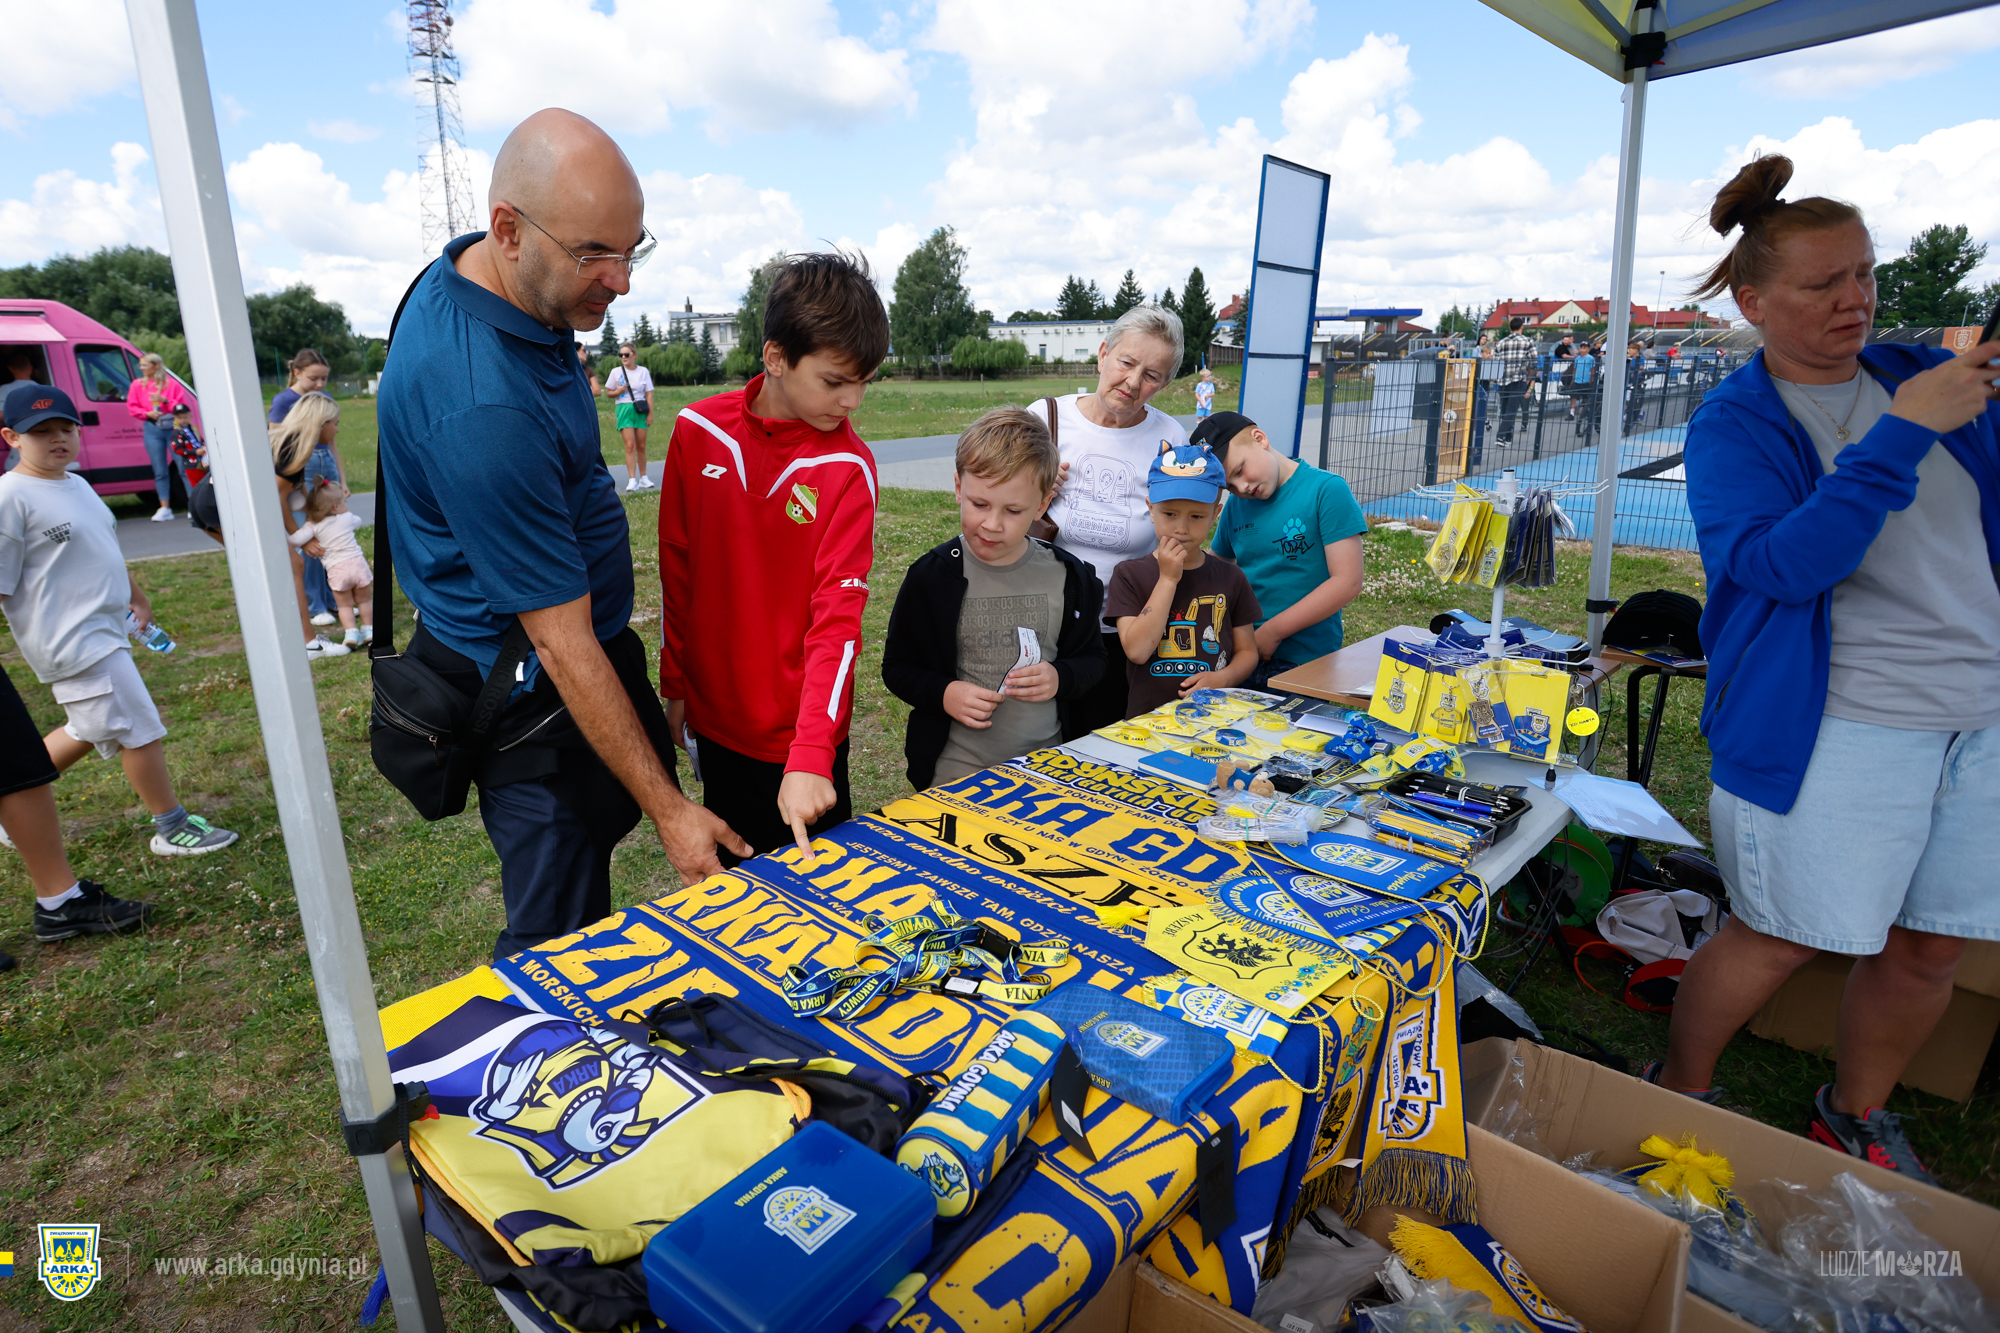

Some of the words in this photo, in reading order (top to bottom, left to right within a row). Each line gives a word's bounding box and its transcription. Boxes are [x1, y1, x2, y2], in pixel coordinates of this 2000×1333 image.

[1070, 517, 1125, 536] SARDINES
[1027, 761, 1076, 783] ARKA
[1080, 777, 1151, 811] GDYNIA
[1064, 788, 1123, 812] PÓŁNOCY
[1125, 808, 1158, 824] FANI,
[926, 787, 990, 819] WYJEŹDZIE,
[995, 814, 1024, 828] CZY
[1024, 824, 1037, 833] U
[1036, 829, 1066, 844] NAS
[1068, 840, 1083, 850] W
[1085, 846, 1129, 864] GDYNI
[905, 840, 983, 876] wiedno
[1303, 880, 1336, 894] ARKA
[846, 841, 918, 872] JESTEŚMY
[915, 870, 980, 900] ZAWSZE
[980, 897, 1016, 922] TAM,
[1072, 942, 1136, 976] NASZA
[519, 957, 605, 1028] MORSKICH
[801, 993, 827, 1012] ARKA
[838, 977, 880, 1018] ARKOWCY
[1203, 992, 1226, 1021] ARKA
[979, 1028, 1018, 1064] ARKA
[1111, 1027, 1135, 1044] ARKA
[551, 1060, 600, 1095] ARKA
[935, 1062, 990, 1113] GDYNIA
[1391, 1055, 1400, 1090] MORSKI
[763, 1166, 788, 1186] ARKA
[734, 1182, 768, 1208] GDYNIA
[779, 1195, 814, 1224] ARKA
